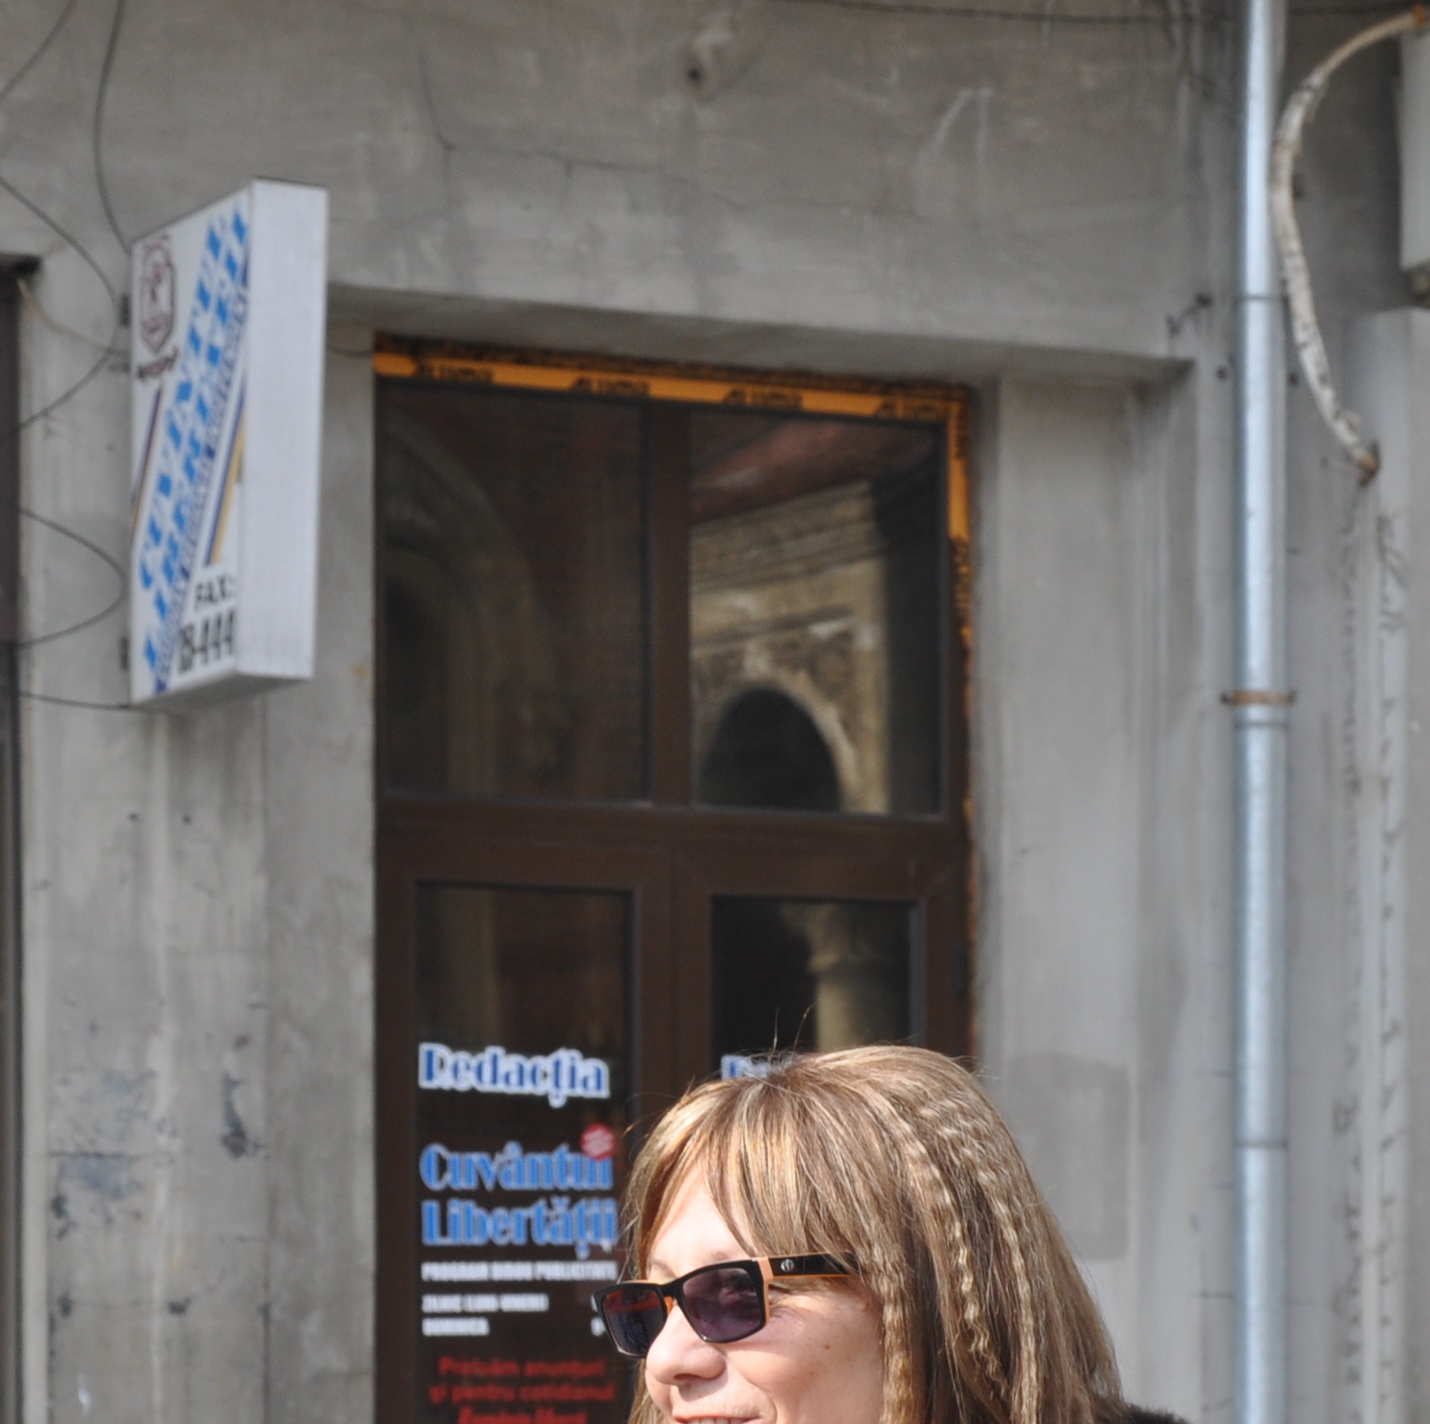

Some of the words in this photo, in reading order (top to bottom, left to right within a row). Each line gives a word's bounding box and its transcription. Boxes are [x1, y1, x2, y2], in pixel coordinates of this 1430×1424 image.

[418, 1043, 610, 1108] Redacția
[419, 1141, 612, 1191] Cuvântul
[422, 1197, 617, 1259] Libertății
